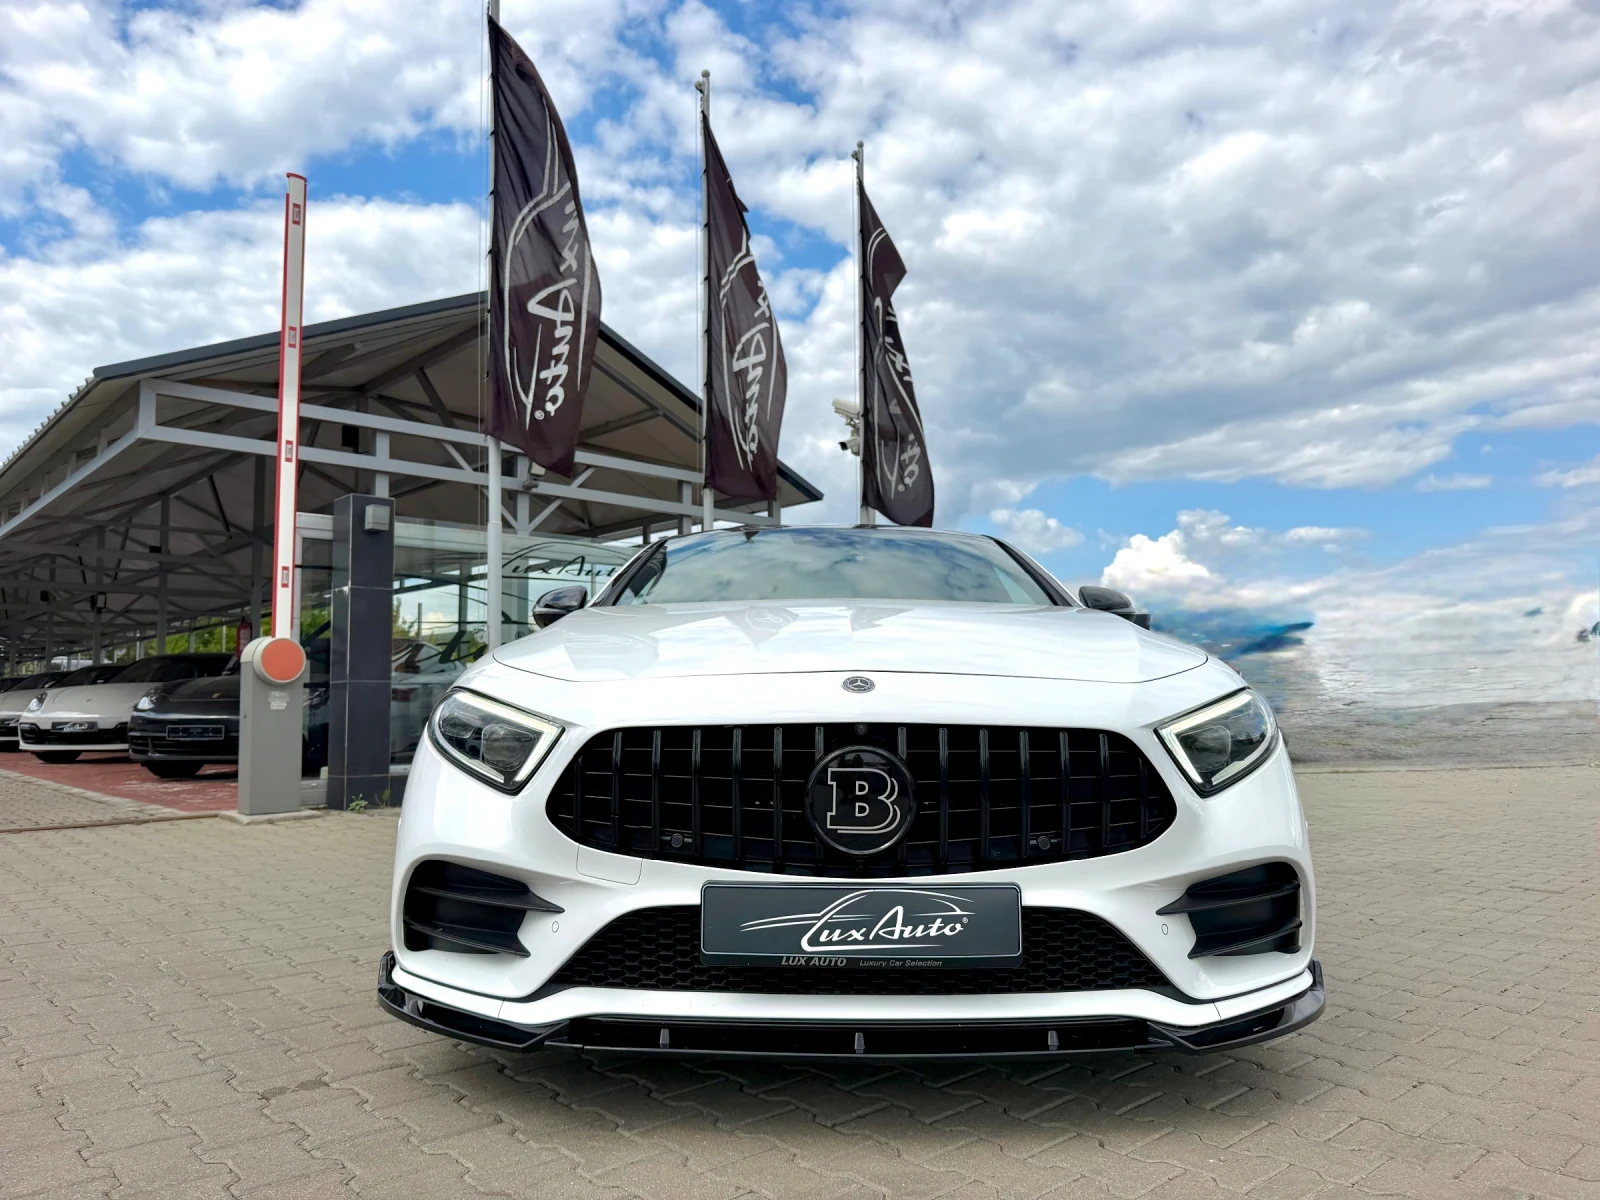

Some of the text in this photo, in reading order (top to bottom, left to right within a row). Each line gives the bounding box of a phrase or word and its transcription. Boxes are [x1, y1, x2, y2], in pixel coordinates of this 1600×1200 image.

[557, 555, 619, 577] Aut
[827, 767, 901, 834] B
[800, 905, 965, 952] Lux Auto
[781, 956, 847, 967] LUX AUTO
[859, 959, 942, 968] Luxury Car Selection
